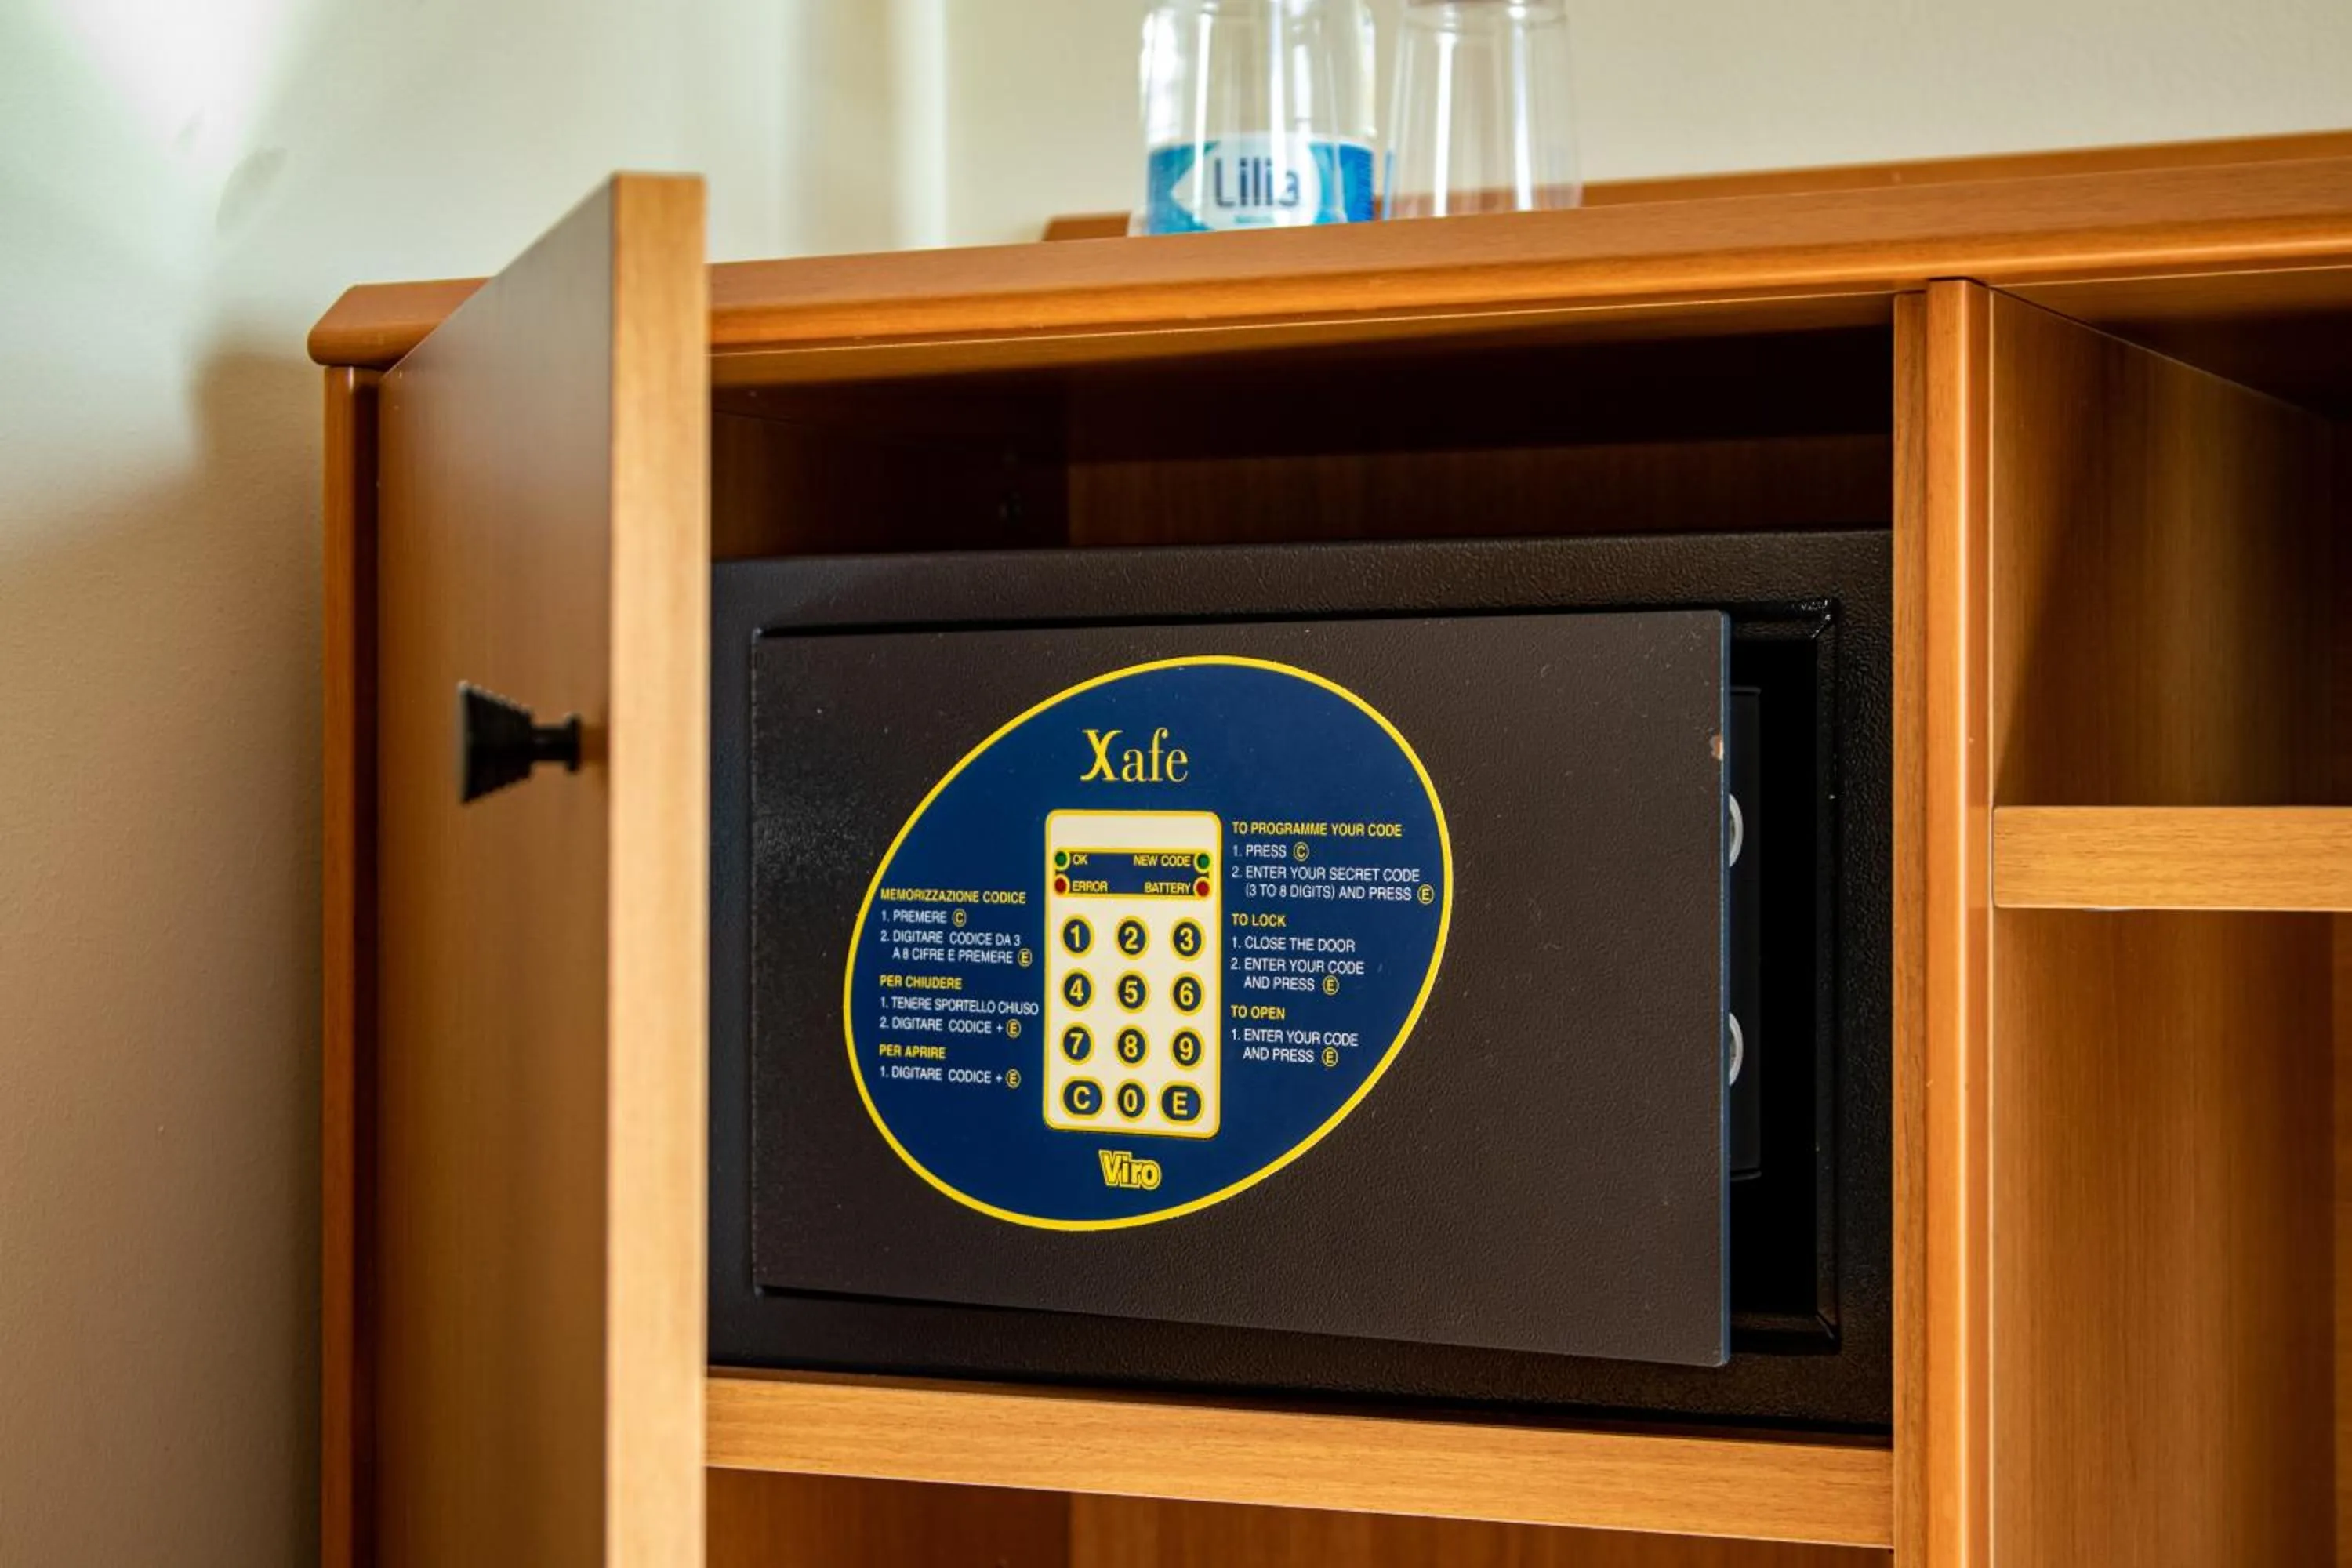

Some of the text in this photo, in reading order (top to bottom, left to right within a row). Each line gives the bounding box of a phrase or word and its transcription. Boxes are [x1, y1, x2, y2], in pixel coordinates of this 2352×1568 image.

[1214, 157, 1298, 207] Lilia
[1080, 727, 1189, 782] Xafe
[1232, 822, 1402, 837] TO PROGRAMME YOUR CODE
[1072, 855, 1088, 864] OK
[1232, 845, 1242, 857] 1.
[1246, 844, 1287, 858] PRESS
[1133, 855, 1191, 867] NEW CODE
[1232, 866, 1420, 882] 2. ENTER YOUR SECRET CODE
[1072, 880, 1108, 892] ERROR
[1145, 882, 1191, 894] BATTERY
[1246, 884, 1255, 897] (3
[1261, 884, 1276, 898] TO
[1279, 884, 1287, 898] 8
[1290, 884, 1335, 900] DIGITS)
[1339, 886, 1365, 899] AND
[1369, 887, 1411, 901] PRESS
[880, 889, 1025, 904] MEMORIZZAZIONE CODICE
[881, 911, 890, 923] 1.
[893, 911, 946, 924] PREMERE
[1232, 913, 1286, 927] TO LOCK
[880, 930, 1021, 946] 2. DIGITARE CODICE DA 3
[1070, 924, 1080, 948] 1
[1124, 927, 1138, 950] 2
[1179, 927, 1193, 951] 3
[1232, 936, 1356, 952] 1. CLOSE THE DOOR
[892, 947, 901, 960] A
[902, 948, 908, 960] 8
[912, 948, 944, 961] CIFRE
[948, 949, 955, 961] E
[958, 949, 1014, 964] PREMERE
[1231, 957, 1364, 975] 2. ENTER YOUR CODE
[880, 975, 962, 990] PER CHIUDERE
[1069, 978, 1084, 1002] 4
[1244, 975, 1269, 989] AND
[1273, 976, 1315, 991] PRESS
[1124, 981, 1138, 1004] 5
[1179, 982, 1194, 1006] 6
[880, 996, 1039, 1016] 1. TENERE SPORTELLO CHIUSO
[1231, 1006, 1285, 1019] TO OPEN
[880, 1017, 889, 1029] 2.
[891, 1016, 942, 1031] DIGITARE
[948, 1018, 991, 1033] CODICE
[1070, 1033, 1084, 1054] 7
[1123, 1034, 1138, 1058] 8
[1232, 1029, 1359, 1047] 1. ENTER YOUR CODE
[879, 1044, 946, 1059] PER APRIRE
[1178, 1036, 1193, 1060] 9
[1243, 1047, 1269, 1060] AND
[1272, 1048, 1315, 1062] PRESS
[880, 1066, 889, 1077] 1.
[891, 1066, 942, 1080] DIGITARE
[948, 1069, 991, 1083] CODICE
[1073, 1086, 1091, 1110] C
[1123, 1089, 1138, 1113] 0
[1173, 1091, 1188, 1116] E
[1098, 1149, 1162, 1189] Viro
